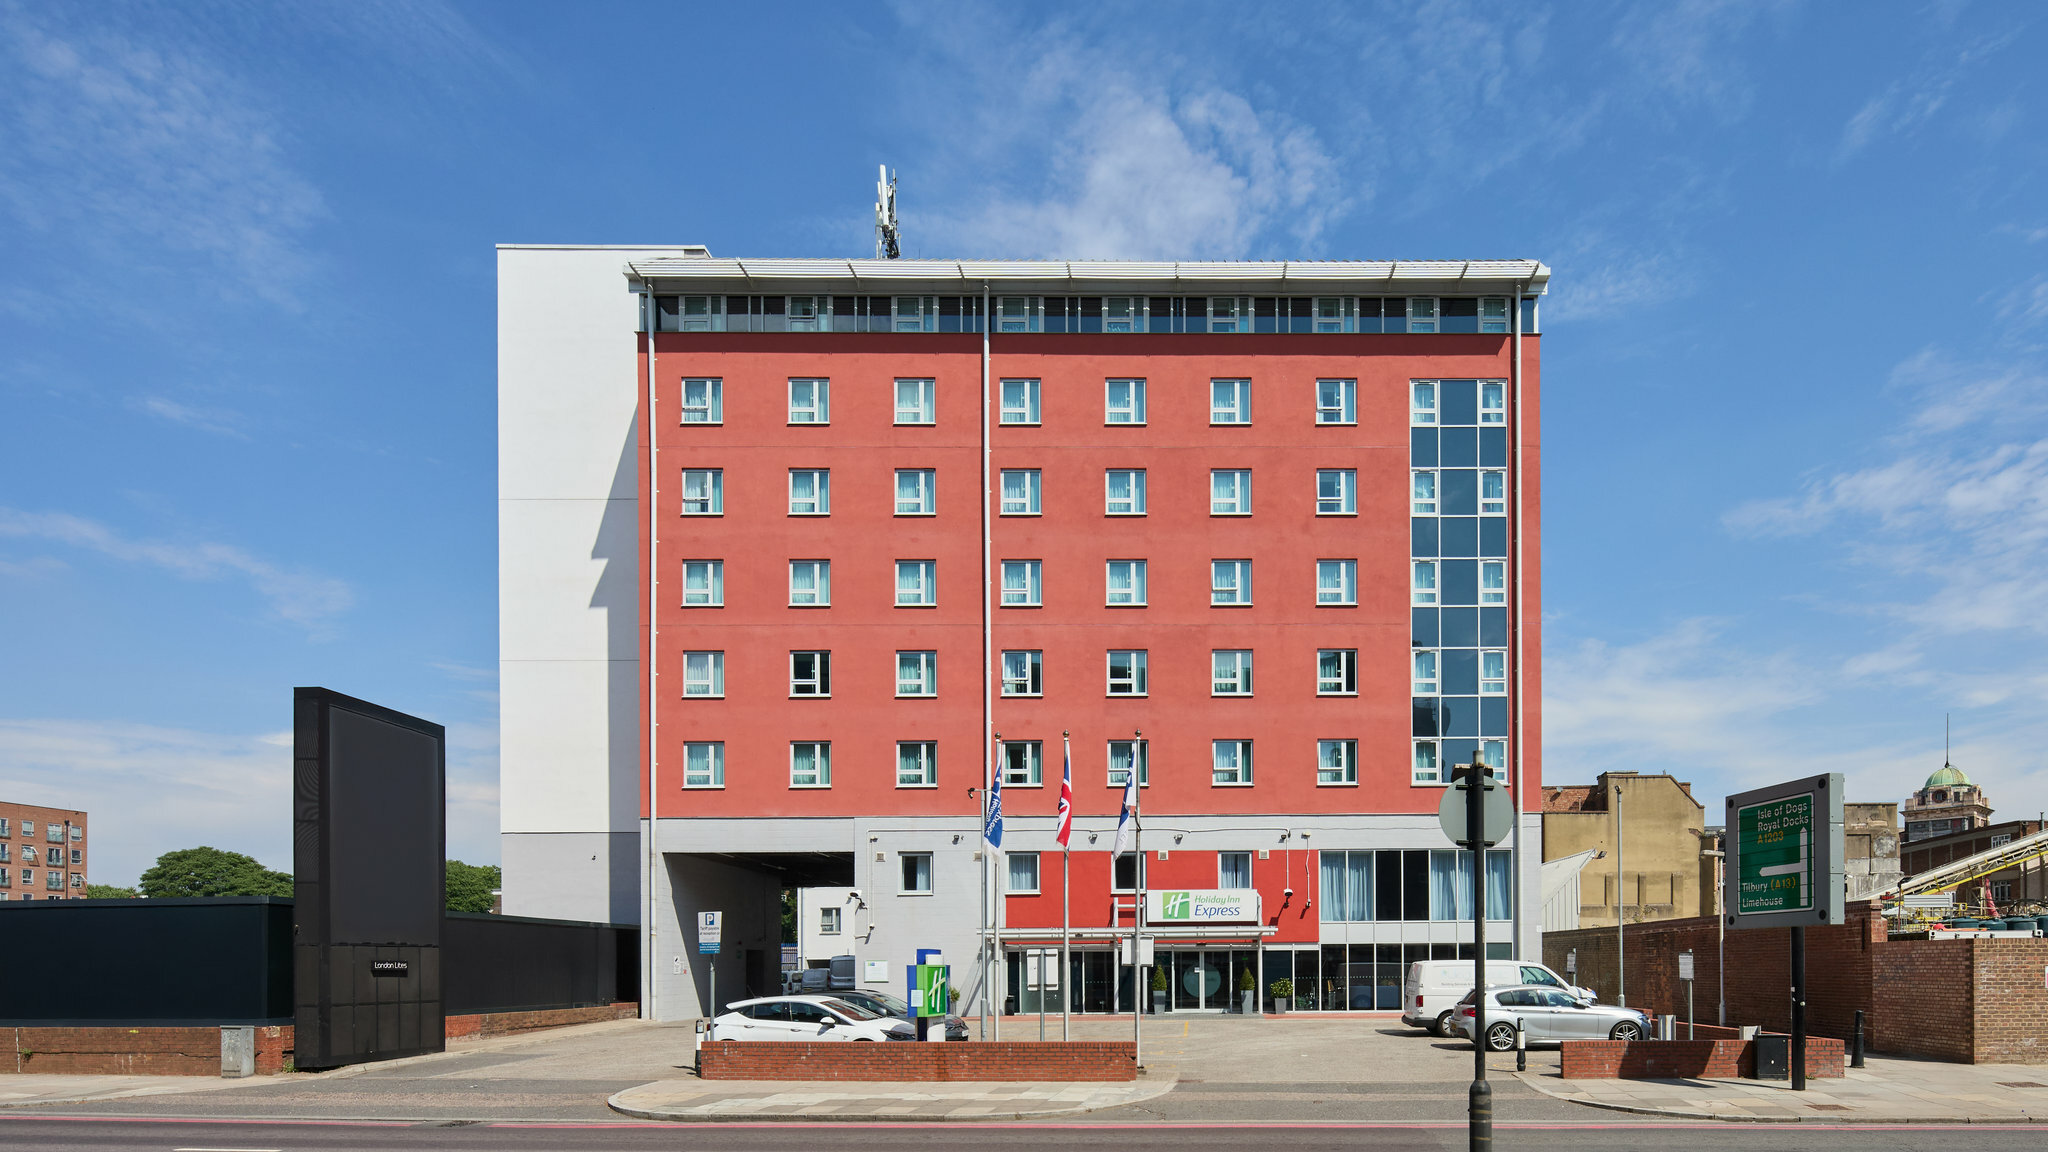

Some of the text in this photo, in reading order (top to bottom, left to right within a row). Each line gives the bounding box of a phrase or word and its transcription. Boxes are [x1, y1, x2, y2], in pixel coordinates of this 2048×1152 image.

[1758, 803, 1808, 819] Isle of Dogs
[1758, 815, 1809, 832] Royal Docks
[1758, 831, 1784, 844] A1203
[1742, 877, 1796, 893] Tilbury (A13)
[1194, 895, 1226, 905] Holiday
[1742, 897, 1784, 908] Limehouse
[1194, 905, 1240, 918] Express
